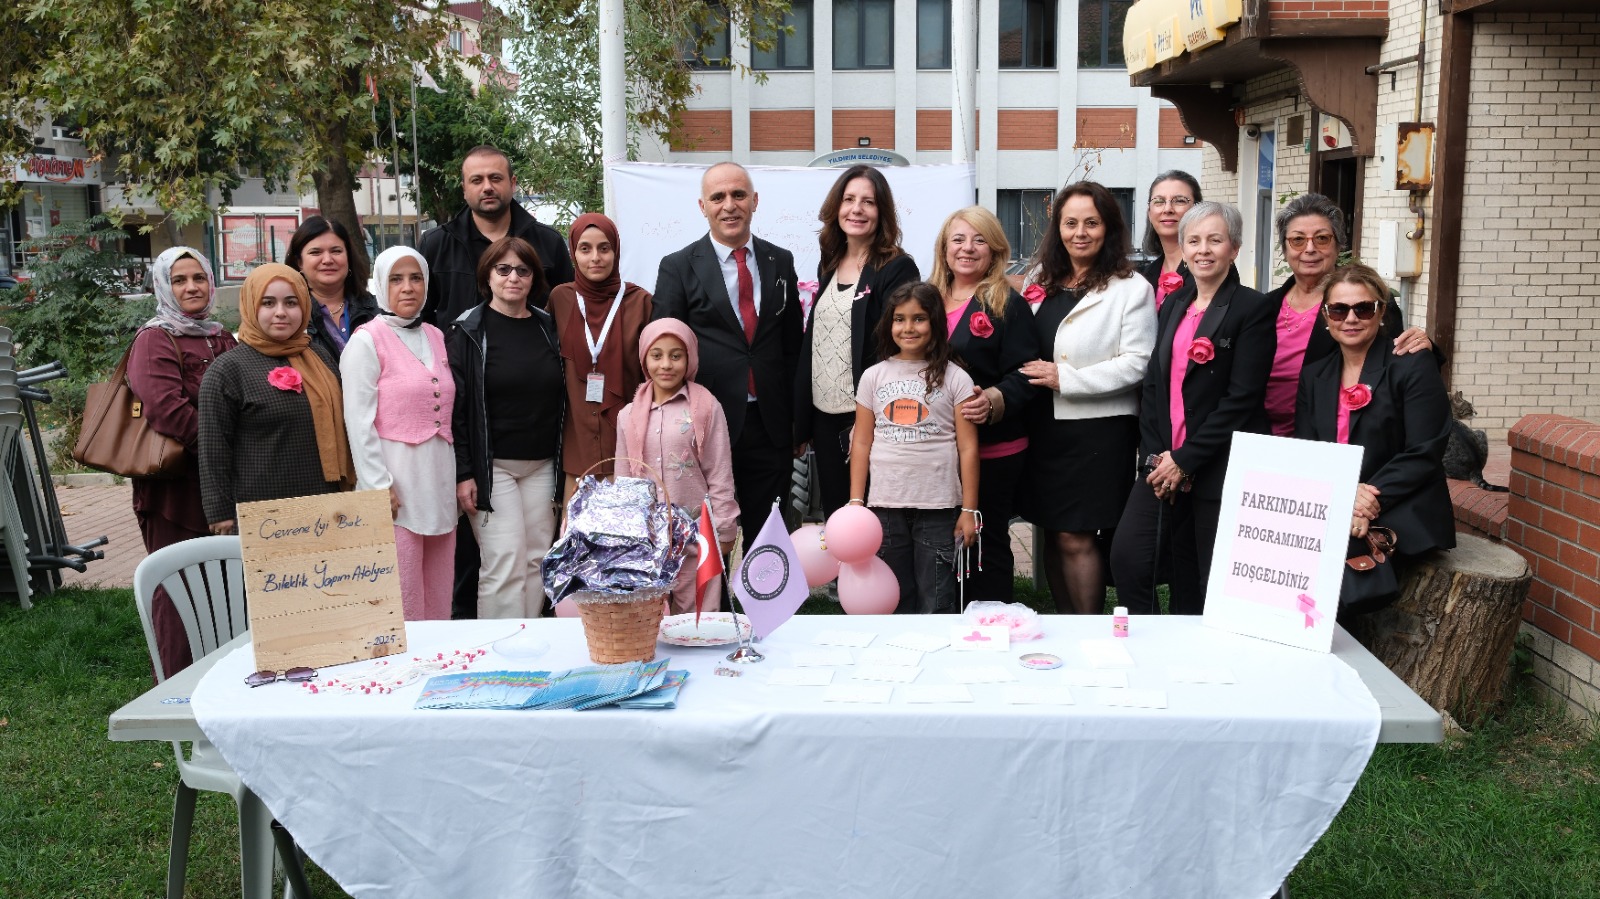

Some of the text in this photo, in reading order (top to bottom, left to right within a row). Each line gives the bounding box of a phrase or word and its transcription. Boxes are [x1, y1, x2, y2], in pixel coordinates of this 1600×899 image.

[828, 154, 857, 164] YILDIRIM
[1241, 491, 1328, 520] FARKINDALIK
[1237, 524, 1322, 552] PROGRAMIMIZA
[263, 573, 308, 592] Bileklik
[1232, 561, 1310, 590] HOŞGELDİNİZ
